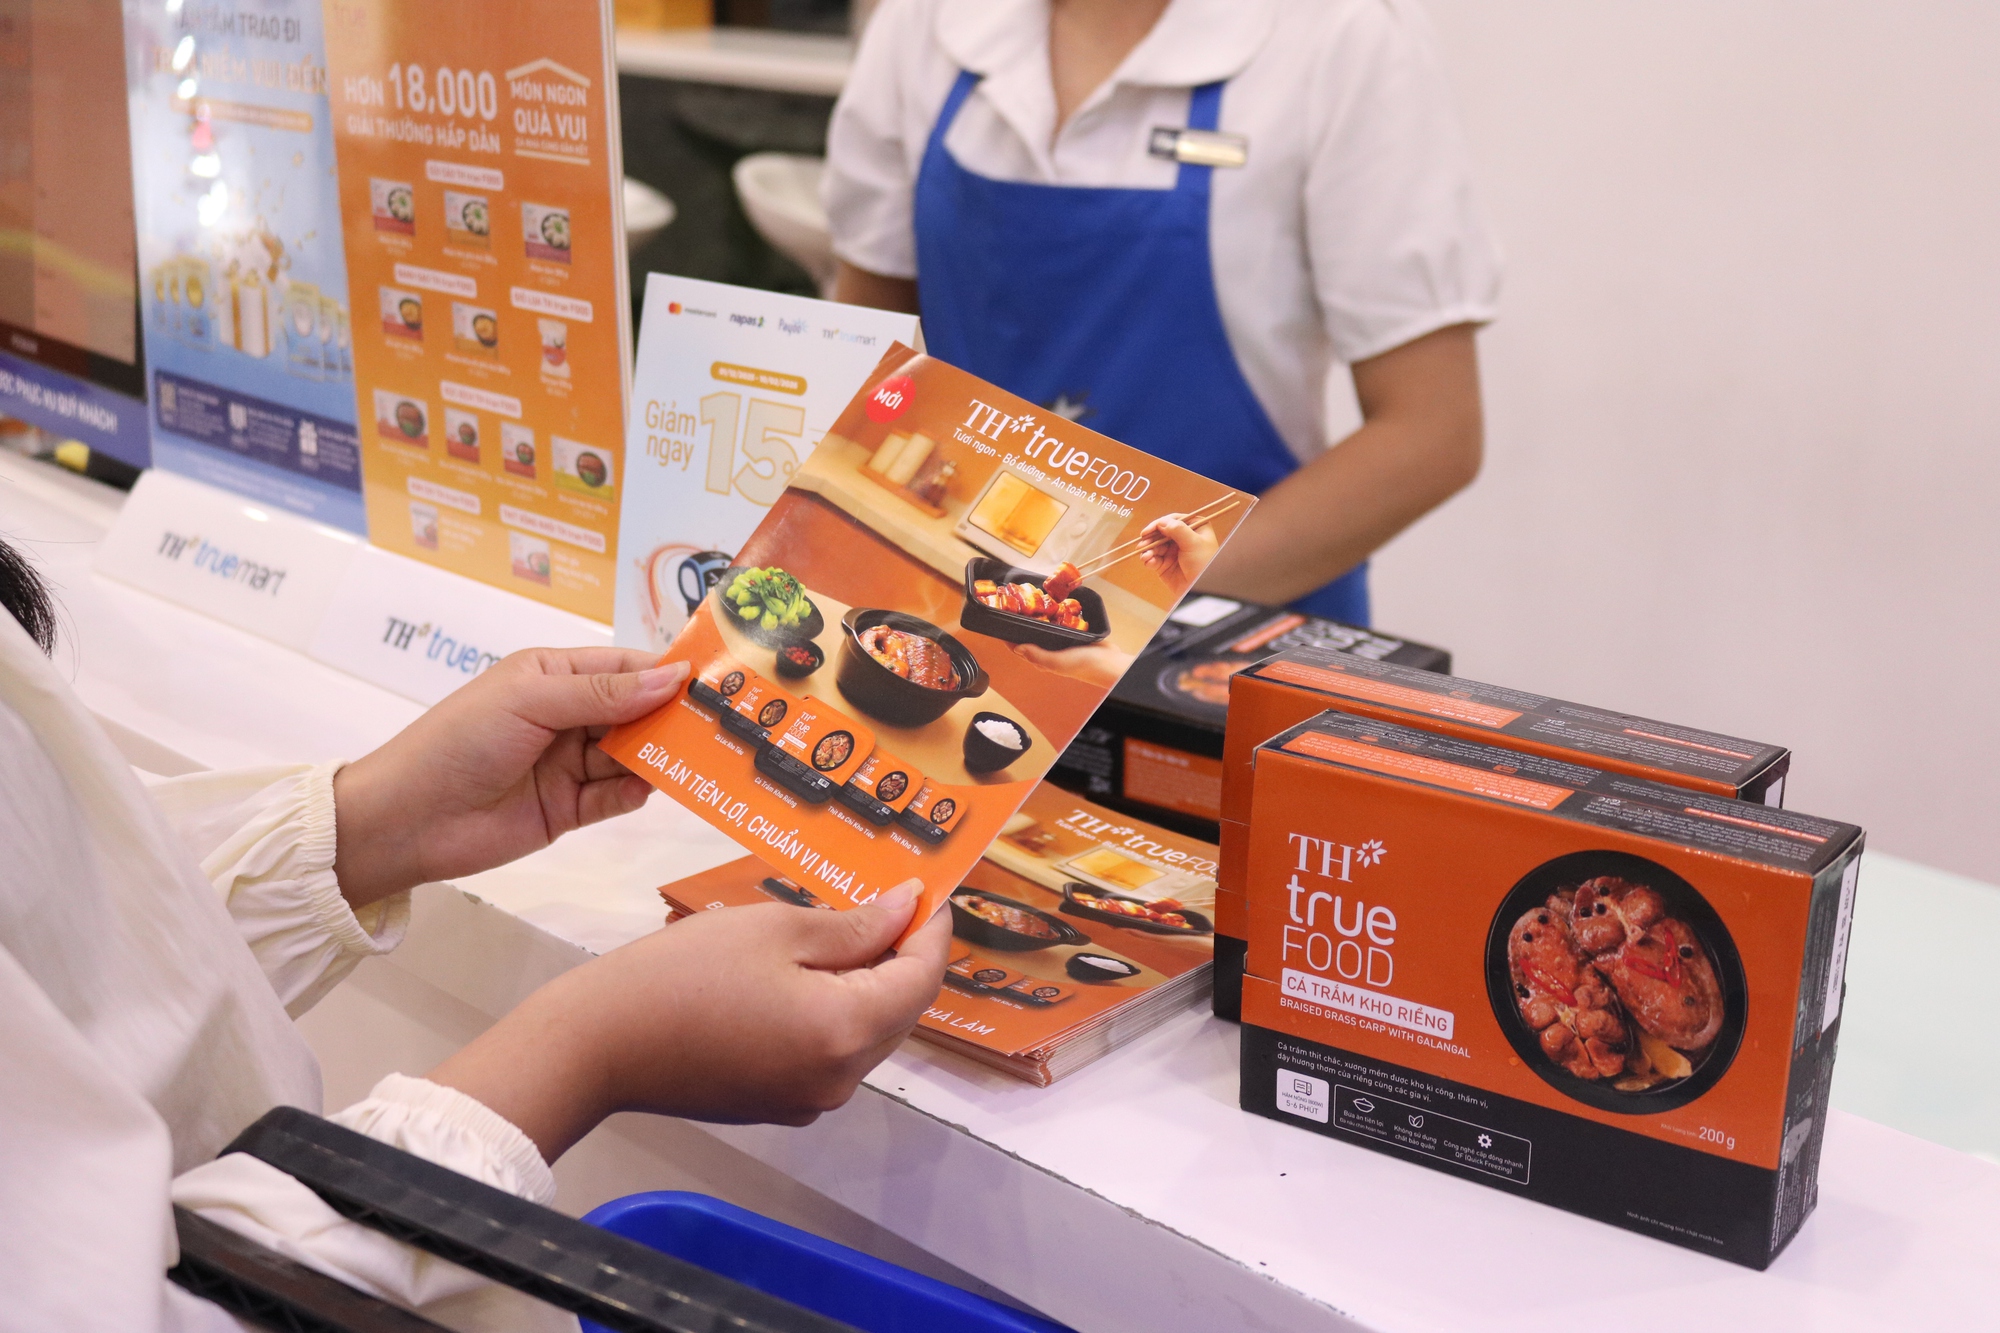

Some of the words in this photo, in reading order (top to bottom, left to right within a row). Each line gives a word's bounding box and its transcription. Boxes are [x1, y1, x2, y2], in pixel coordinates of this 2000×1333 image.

[240, 12, 279, 41] TRAO
[284, 20, 300, 43] ĐI
[388, 62, 499, 120] 18,000
[511, 79, 545, 102] MÓN
[547, 84, 587, 107] NGON
[514, 103, 552, 137] QUÀ
[556, 113, 587, 141] VUI
[873, 388, 904, 410] MỚI
[645, 400, 697, 437] Giảm
[962, 398, 1012, 442] TH
[645, 434, 695, 472] ngay
[953, 428, 973, 448] Tươi
[973, 437, 996, 458] ngon
[1002, 450, 1017, 466] Bổ
[1016, 460, 1046, 483] dưỡng
[1051, 476, 1066, 490] An
[1065, 482, 1086, 499] toàn
[1088, 492, 1096, 503] &
[1096, 494, 1117, 513] Tiện
[1117, 503, 1133, 519] lợi
[158, 531, 187, 561] TH
[381, 616, 419, 652] TH
[426, 627, 504, 677] truem
[793, 718, 811, 733] true
[636, 741, 666, 772] BỮA
[666, 758, 689, 787] ĂN
[689, 772, 725, 809] TIỆN
[719, 790, 749, 826] LỢI,
[747, 813, 799, 861] CHUẨN
[799, 845, 817, 876] VỊ
[811, 857, 857, 896] NHÀ
[850, 886, 882, 908] LÀ
[1066, 809, 1112, 835] TH
[1288, 832, 1356, 884] TH
[1286, 874, 1397, 946] true
[1283, 924, 1395, 988] FOOD
[925, 1003, 954, 1023] HÀ
[949, 1016, 996, 1037] LÀM
[1287, 975, 1307, 994] CÁ
[1311, 981, 1355, 1007] TRẮM
[1359, 998, 1393, 1017] KHO
[1397, 1006, 1448, 1032] RIỀNG
[1280, 998, 1322, 1017] BRAISED
[1324, 1010, 1357, 1026] GRASS
[1359, 1020, 1387, 1034] CARP
[1388, 1027, 1414, 1043] WITH
[1416, 1035, 1472, 1058] GALANGAL
[1277, 1041, 1288, 1051] Cá
[1289, 1045, 1308, 1056] trắm
[1309, 1050, 1322, 1061] thịt
[1323, 1055, 1343, 1068] chắc,
[1344, 1061, 1368, 1075] xương
[1369, 1067, 1389, 1079] mềm
[1390, 1074, 1409, 1086] được
[1410, 1078, 1425, 1089] kho
[1435, 1087, 1456, 1100] công,
[1457, 1093, 1478, 1105] thấm
[1291, 1056, 1315, 1070] hương
[1316, 1062, 1337, 1075] thơm
[1337, 1070, 1351, 1079] của
[1352, 1074, 1373, 1087] riềng
[1374, 1079, 1393, 1092] cùng
[1394, 1086, 1408, 1095] các
[1409, 1090, 1421, 1100] gia
[1286, 1100, 1298, 1109] 5-6
[1298, 1103, 1319, 1115] PHÚT
[1343, 1109, 1356, 1119] Bữa
[1355, 1113, 1365, 1122] ăn
[1364, 1116, 1377, 1126] tiện
[1376, 1119, 1385, 1128] lợi
[1393, 1124, 1413, 1138] Không
[1413, 1130, 1422, 1139] sử
[1422, 1132, 1438, 1145] dụng
[1395, 1133, 1408, 1143] chất
[1408, 1137, 1420, 1146] bảo
[1420, 1142, 1436, 1152] quản
[1698, 1126, 1725, 1145] 200
[1726, 1137, 1736, 1150] g
[1465, 1154, 1484, 1166] (Quick
[1484, 1160, 1514, 1175] Freezing)
